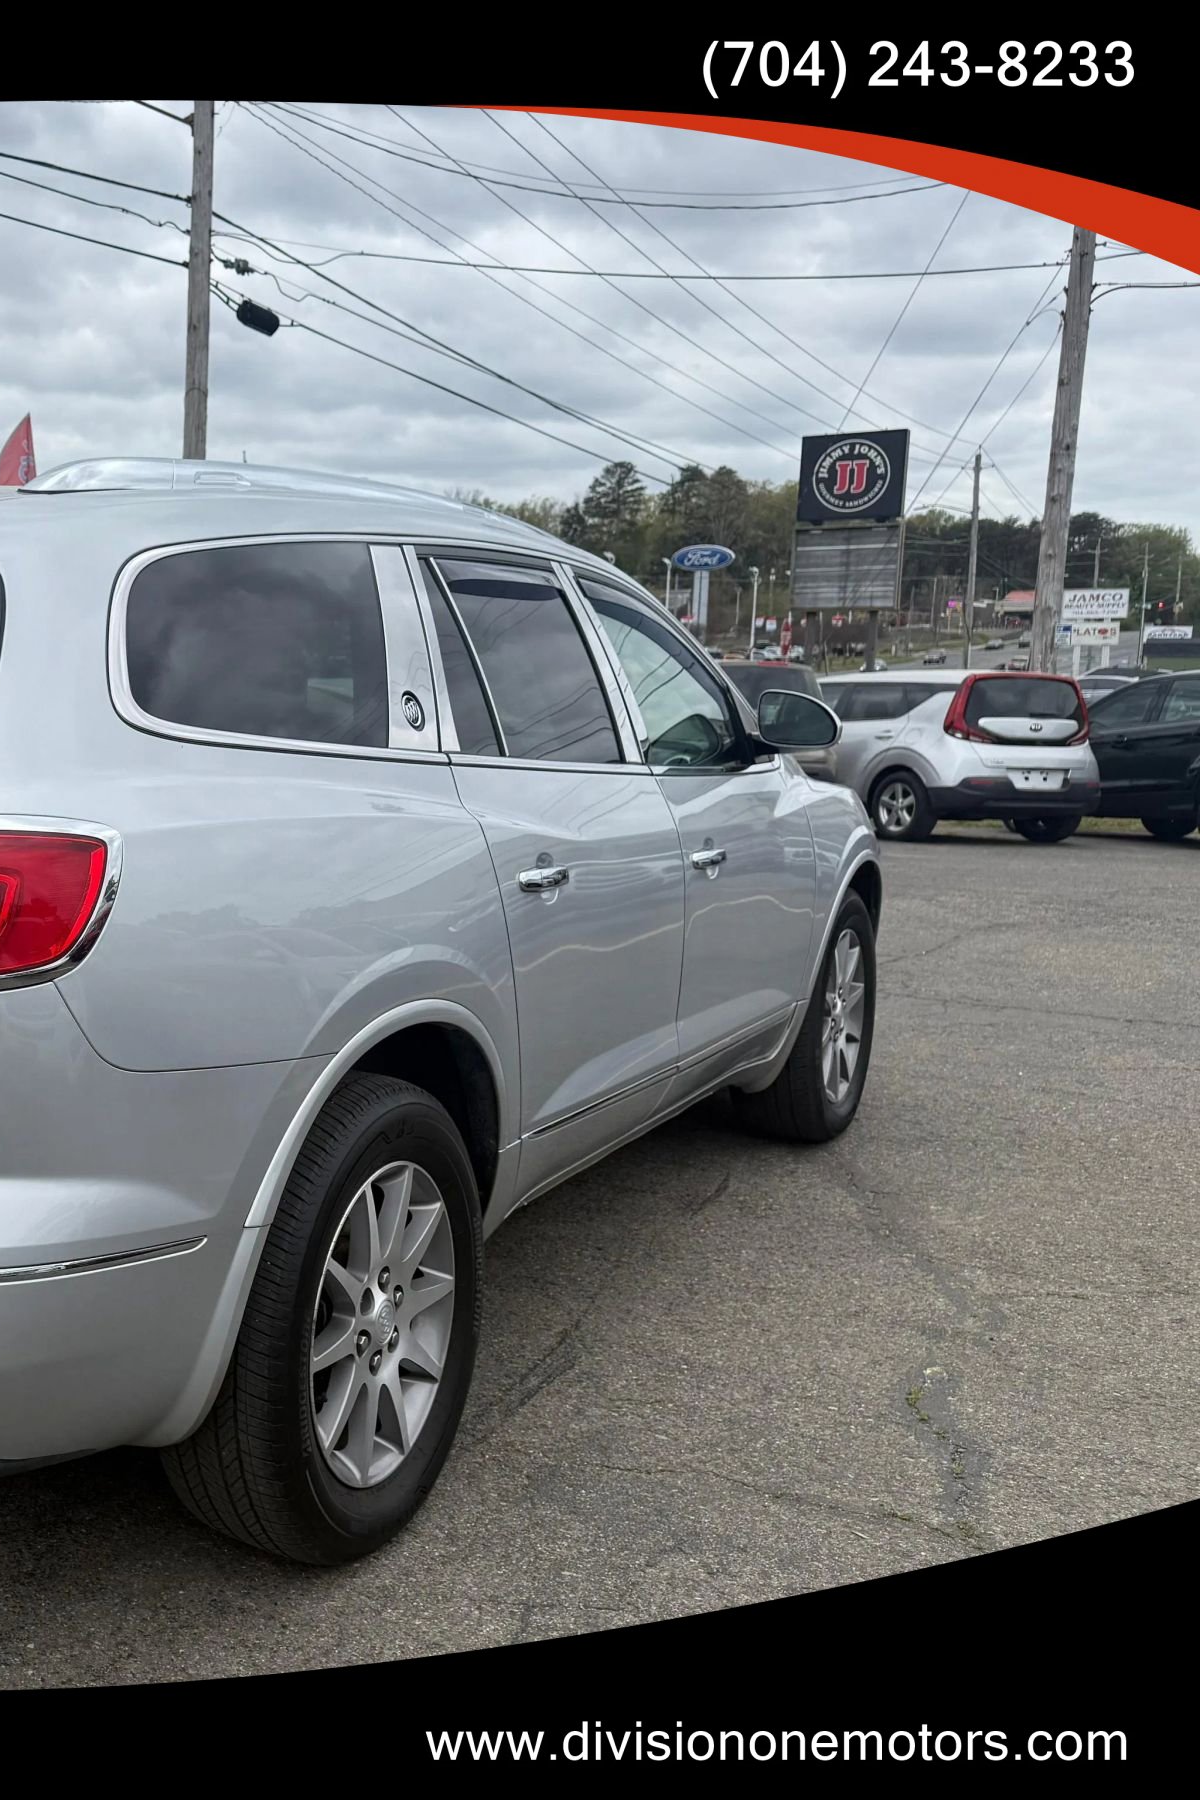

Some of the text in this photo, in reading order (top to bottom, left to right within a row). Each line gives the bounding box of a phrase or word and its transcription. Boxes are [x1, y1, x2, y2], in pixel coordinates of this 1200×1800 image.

[818, 444, 850, 478] JIMMY
[833, 460, 869, 494] JJ
[684, 551, 721, 566] Ford
[1068, 592, 1123, 603] JAMCO
